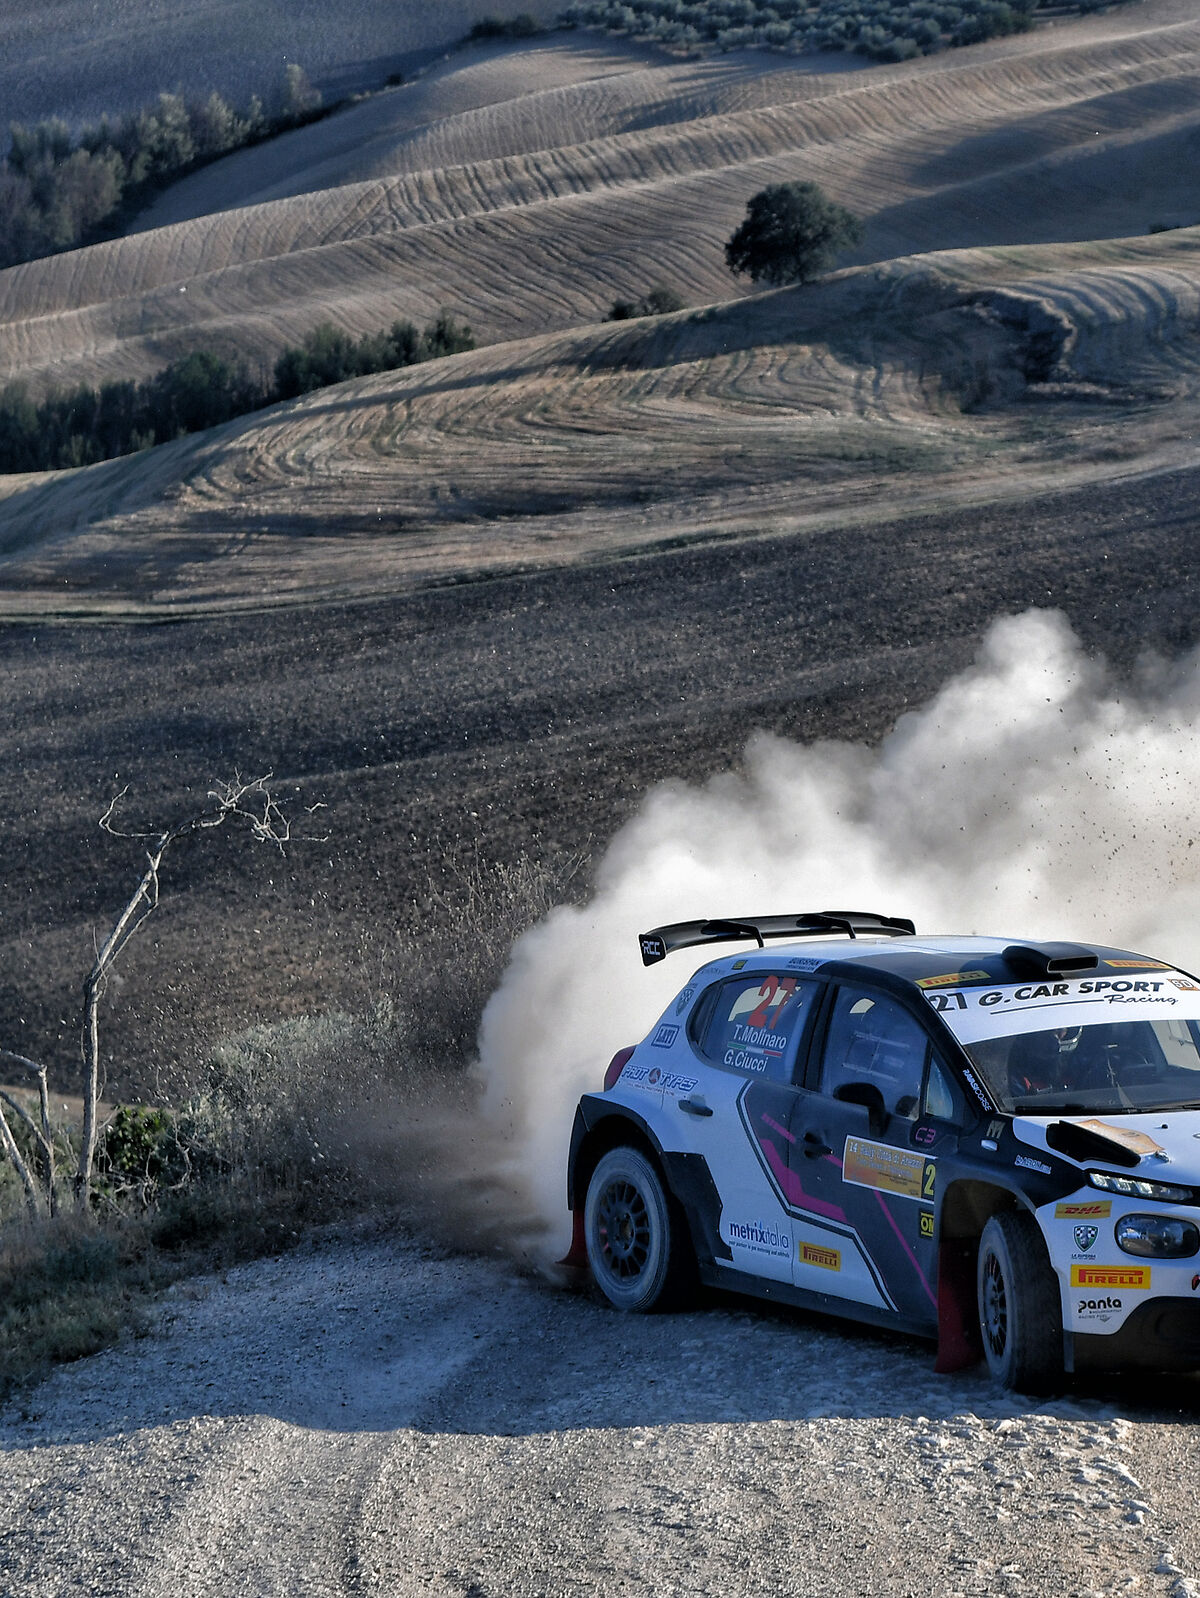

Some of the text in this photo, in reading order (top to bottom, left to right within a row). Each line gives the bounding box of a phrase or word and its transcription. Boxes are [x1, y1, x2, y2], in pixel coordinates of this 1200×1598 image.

[1078, 980, 1165, 994] SPORT
[1104, 994, 1179, 1005] Racing
[733, 1024, 787, 1049] T.Molinaro
[723, 1051, 769, 1073] G.Ciucci
[915, 1127, 937, 1144] C3
[1064, 1205, 1102, 1215] DHL
[803, 1245, 838, 1267] PIRELLI
[1078, 1268, 1144, 1285] PIRELLI
[1077, 1296, 1122, 1313] panta
